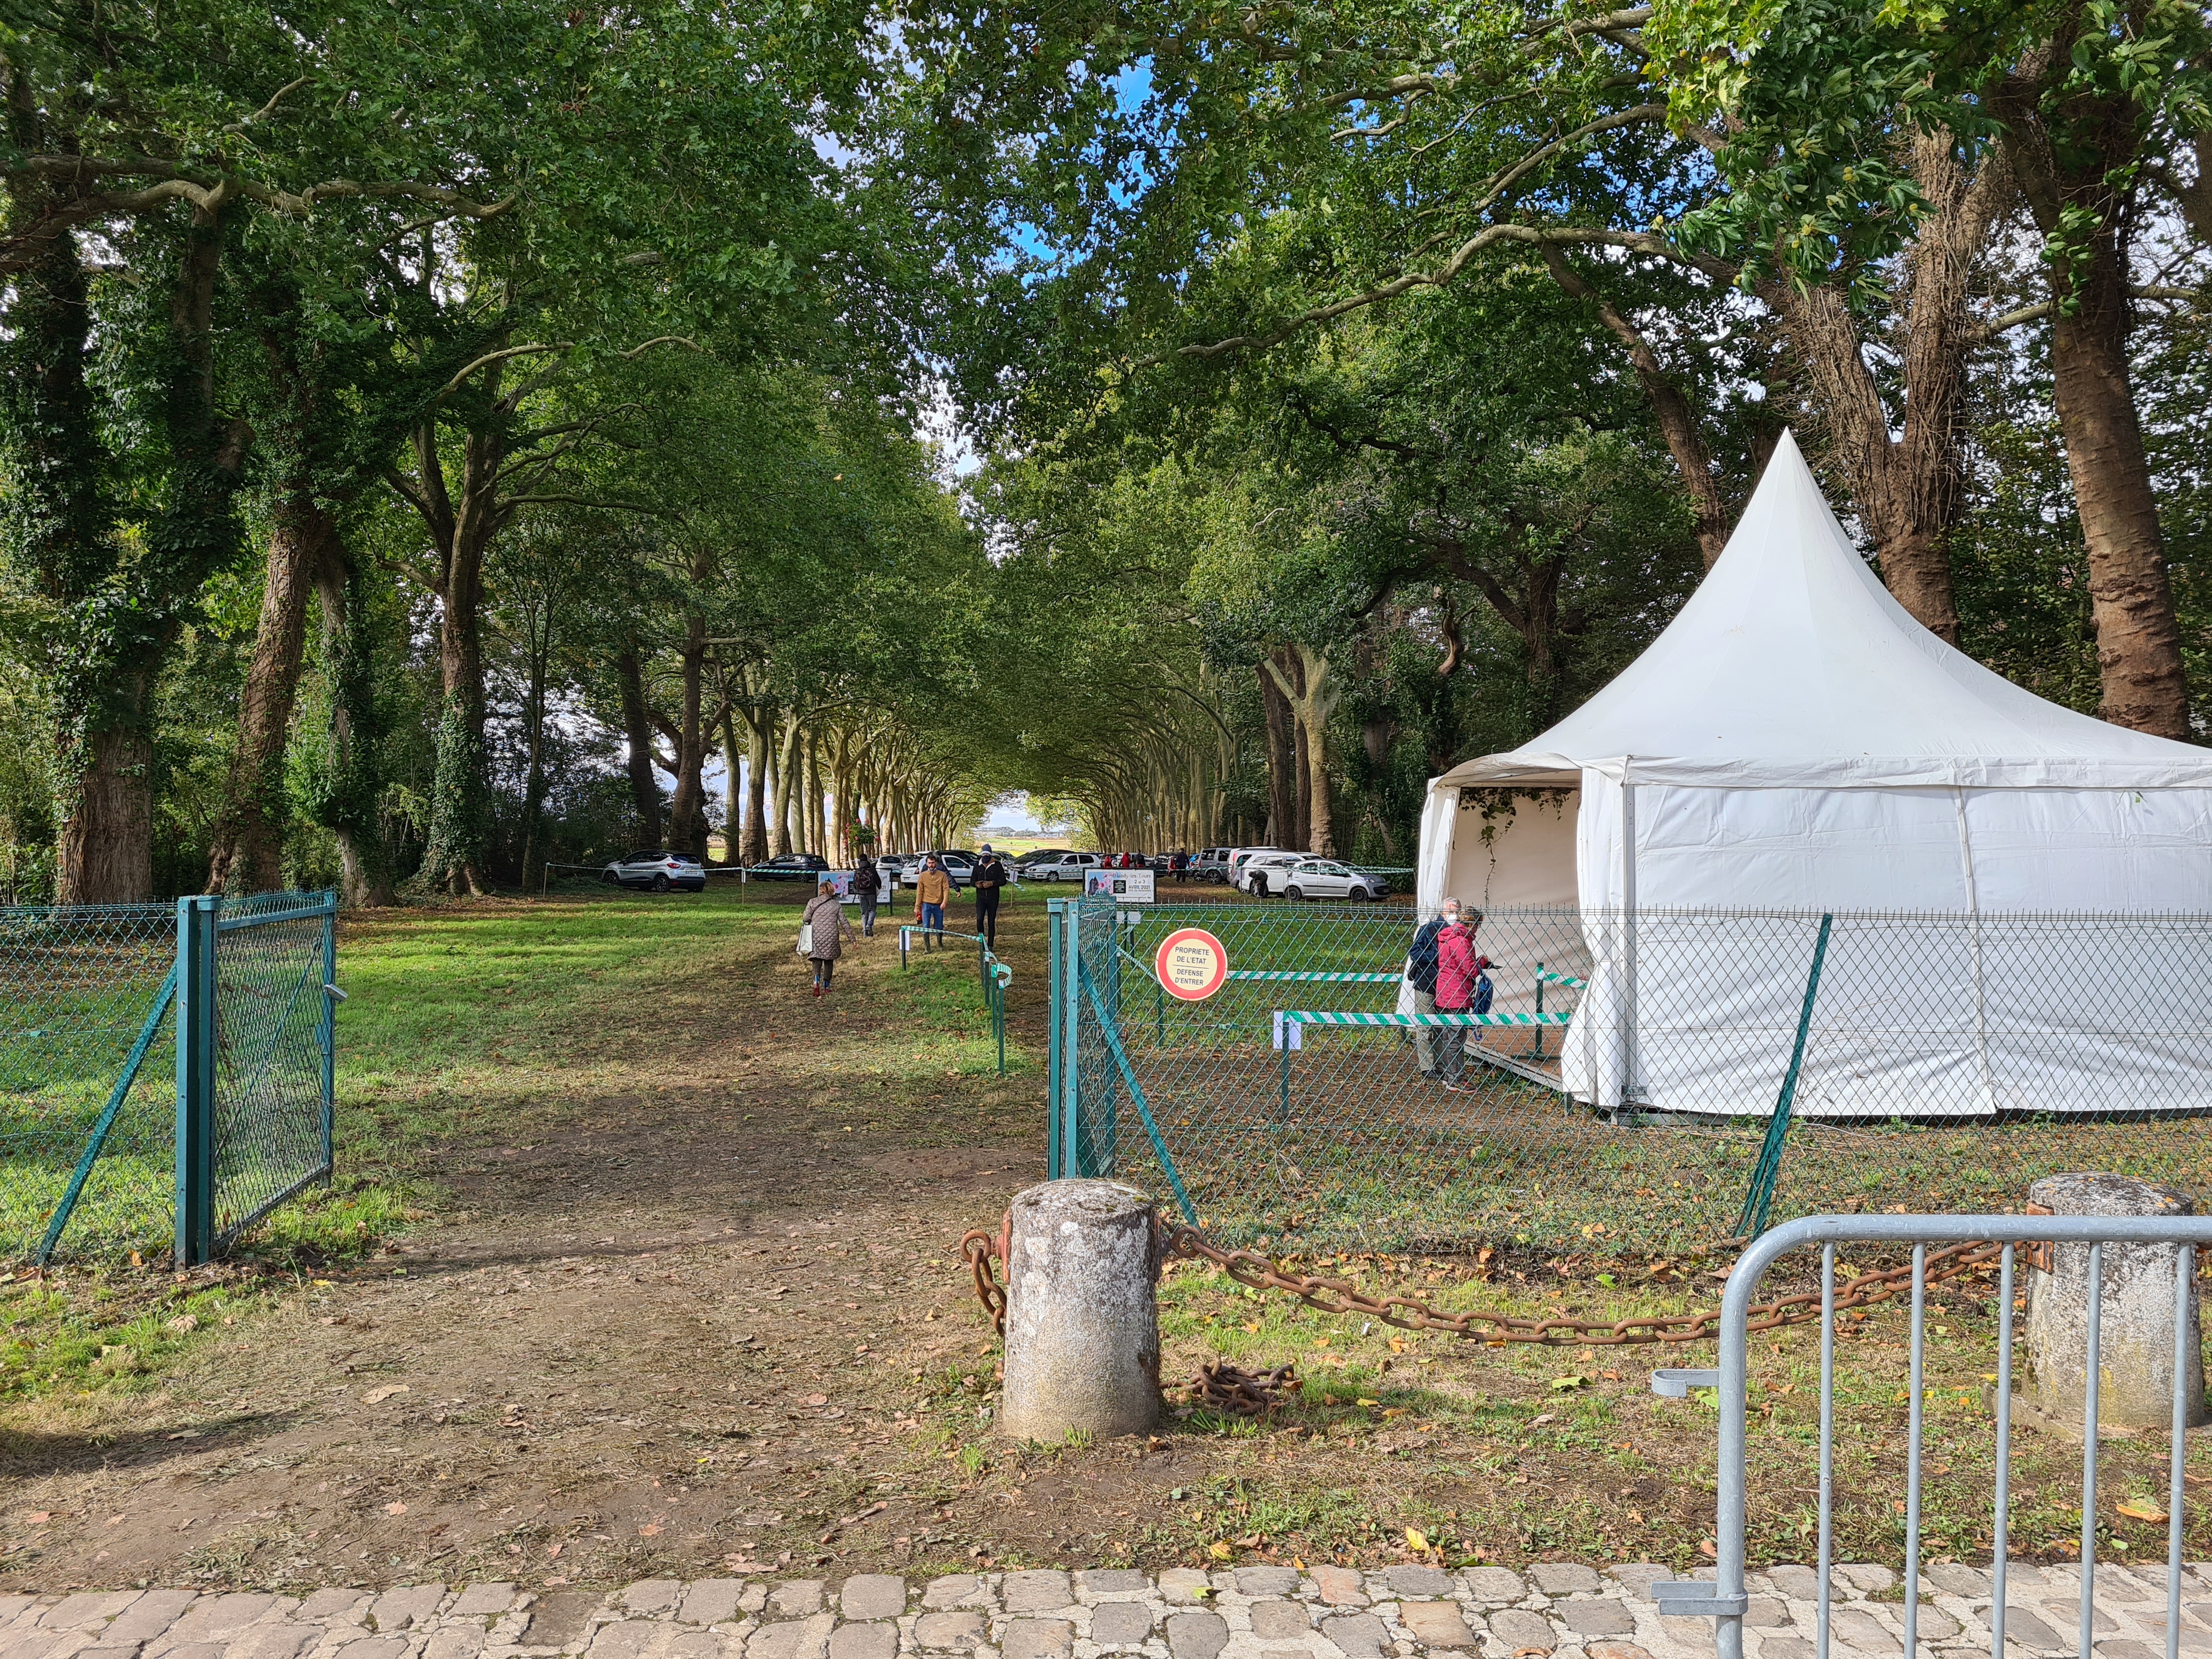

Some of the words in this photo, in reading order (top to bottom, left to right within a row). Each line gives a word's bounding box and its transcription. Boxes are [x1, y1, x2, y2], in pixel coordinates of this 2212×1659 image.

[1175, 946, 1210, 956] PROPRIETE
[1177, 968, 1204, 977] DEFENSE
[1175, 977, 1204, 985] D'ENTRER
